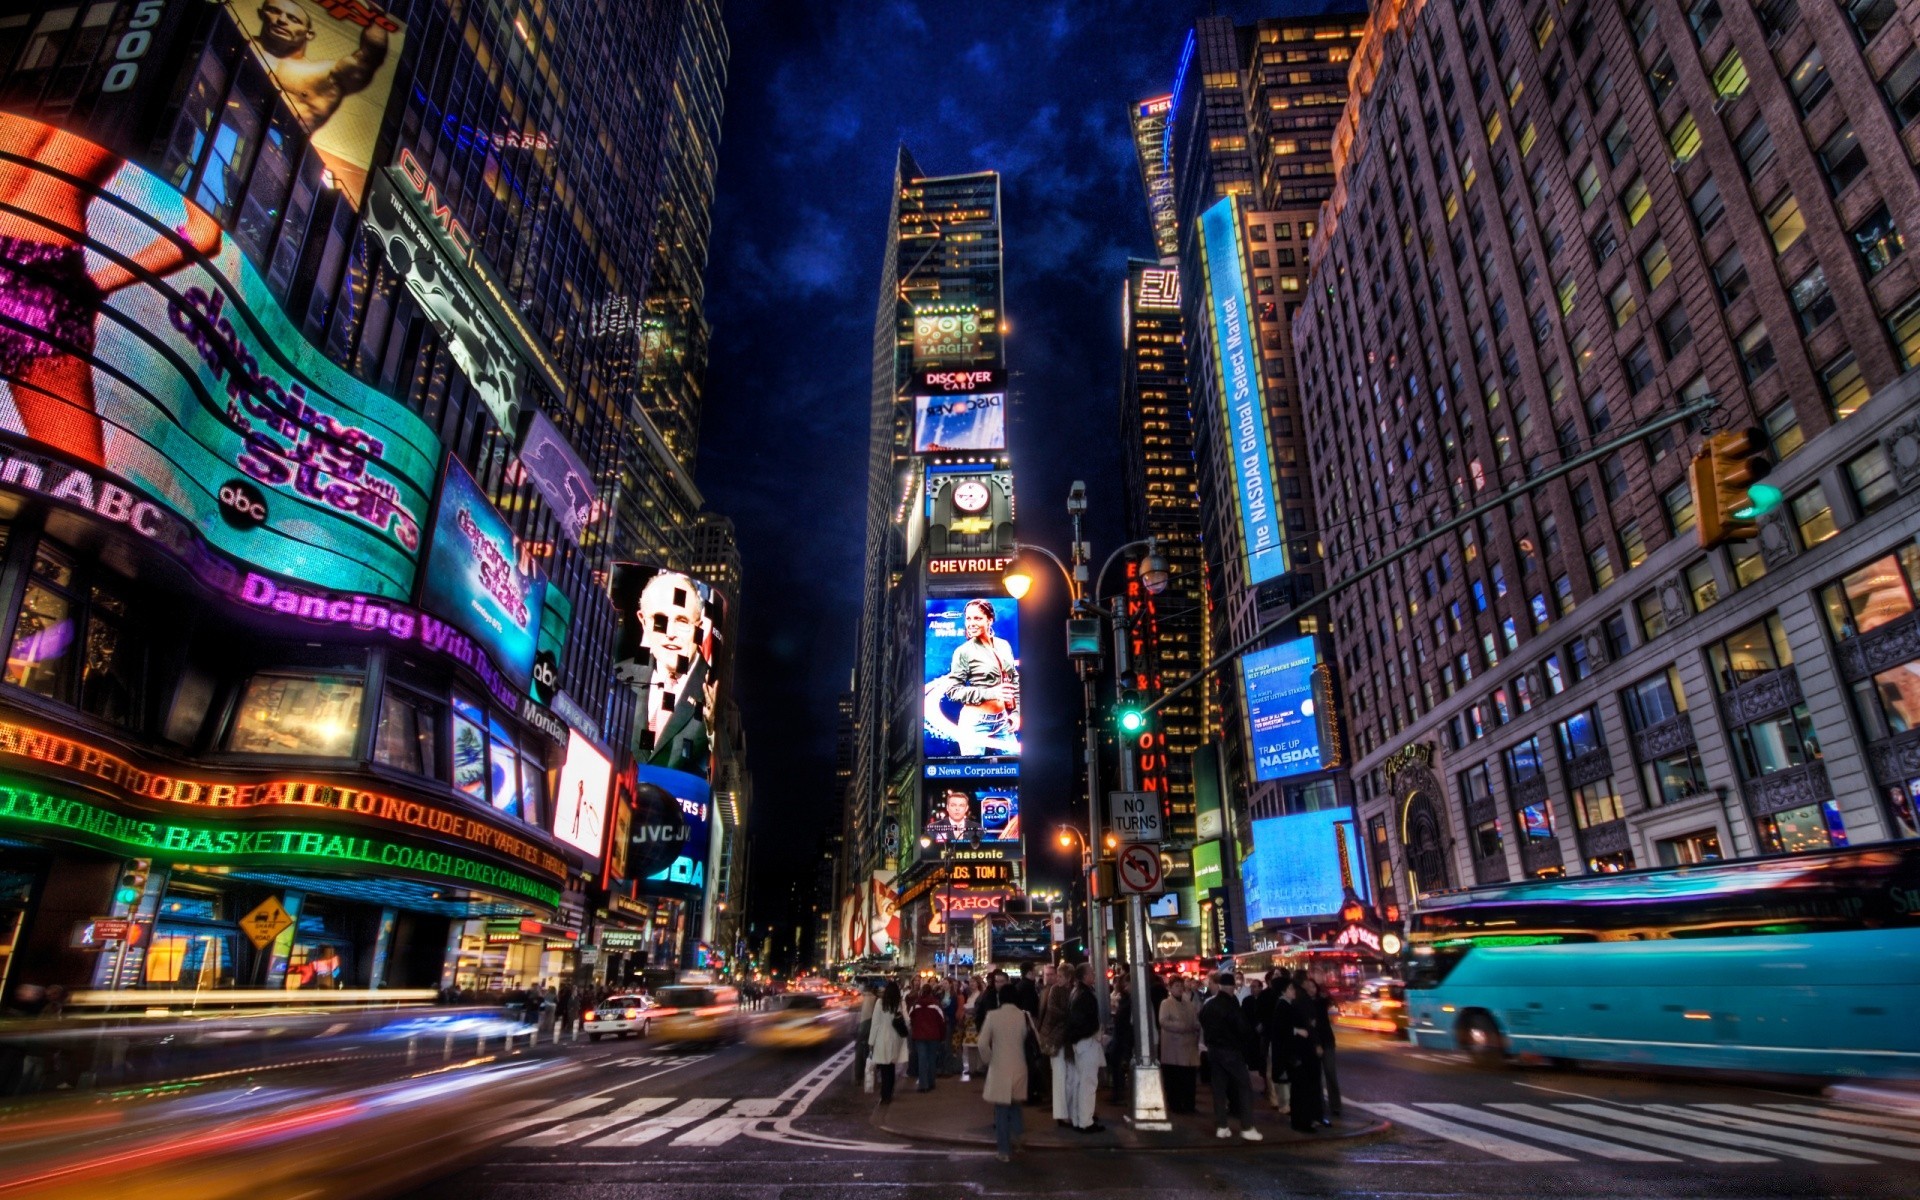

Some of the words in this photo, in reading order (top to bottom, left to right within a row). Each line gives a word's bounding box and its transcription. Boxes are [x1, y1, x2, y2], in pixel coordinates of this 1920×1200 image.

[102, 0, 160, 93] 500
[390, 193, 404, 215] THE
[403, 210, 417, 234] NEW
[400, 148, 471, 258] GMC
[433, 249, 475, 311] YUKON
[474, 261, 487, 281] WE
[1223, 295, 1242, 352] Market
[920, 344, 973, 355] TARGET
[168, 286, 386, 481] dancing
[927, 372, 992, 385] DISCOVER
[943, 382, 976, 391] CARD
[1229, 349, 1249, 401] Select
[1236, 401, 1257, 453] Global
[50, 468, 163, 537] ABC
[219, 486, 267, 521] abc
[362, 472, 402, 503] with
[1243, 452, 1267, 524] NASDAQ
[1255, 524, 1271, 560] The
[243, 572, 415, 641] Dancing
[420, 613, 473, 668] With
[1259, 742, 1287, 755] TRADE
[1288, 739, 1300, 749] UP
[938, 766, 961, 776] News
[964, 765, 1017, 777] Corporation
[210, 782, 327, 807] RECALL
[332, 786, 374, 814] TO
[380, 795, 464, 837] INCLUDE
[465, 820, 494, 846] DRY
[985, 805, 1007, 814] 80
[1115, 815, 1157, 831] TURNS
[1124, 799, 1145, 813] NO
[30, 792, 157, 848] WOMEN'S
[164, 826, 384, 863] BASKETBALL
[381, 843, 452, 875] COACH
[454, 858, 500, 885] POKEY
[632, 825, 673, 843] JVC
[975, 866, 996, 879] TOM
[601, 931, 642, 940] STARBUCKS
